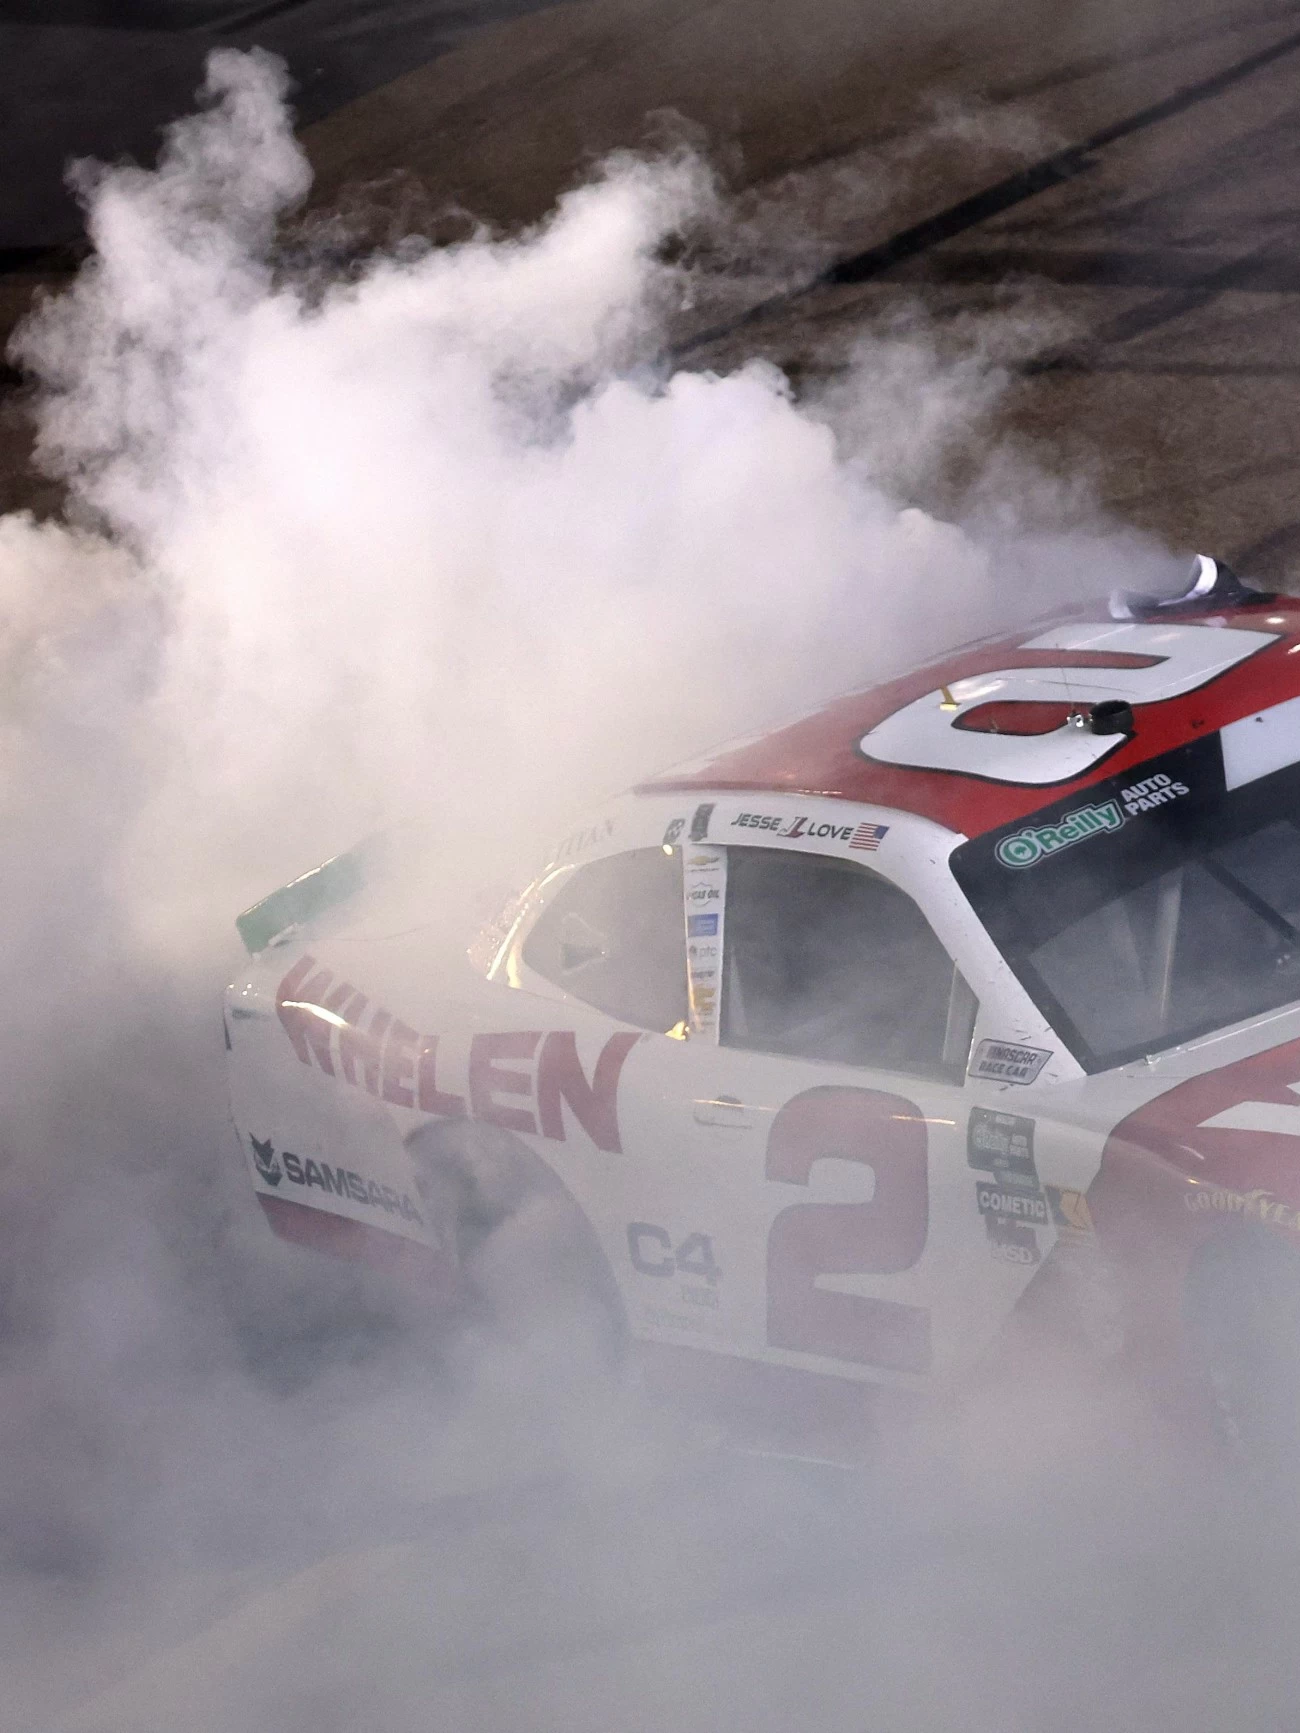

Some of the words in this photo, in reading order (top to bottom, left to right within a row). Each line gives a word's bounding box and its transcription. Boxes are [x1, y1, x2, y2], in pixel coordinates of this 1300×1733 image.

[1121, 774, 1171, 802] AUTO
[1125, 782, 1190, 816] PARTS
[731, 812, 782, 831] JESSE
[807, 822, 854, 840] LOVE
[998, 804, 1121, 867] O'Reilly
[275, 954, 643, 1155] WHELEN
[980, 1190, 1047, 1218] COMETIC
[766, 1085, 933, 1374] 2
[627, 1221, 723, 1287] C4
